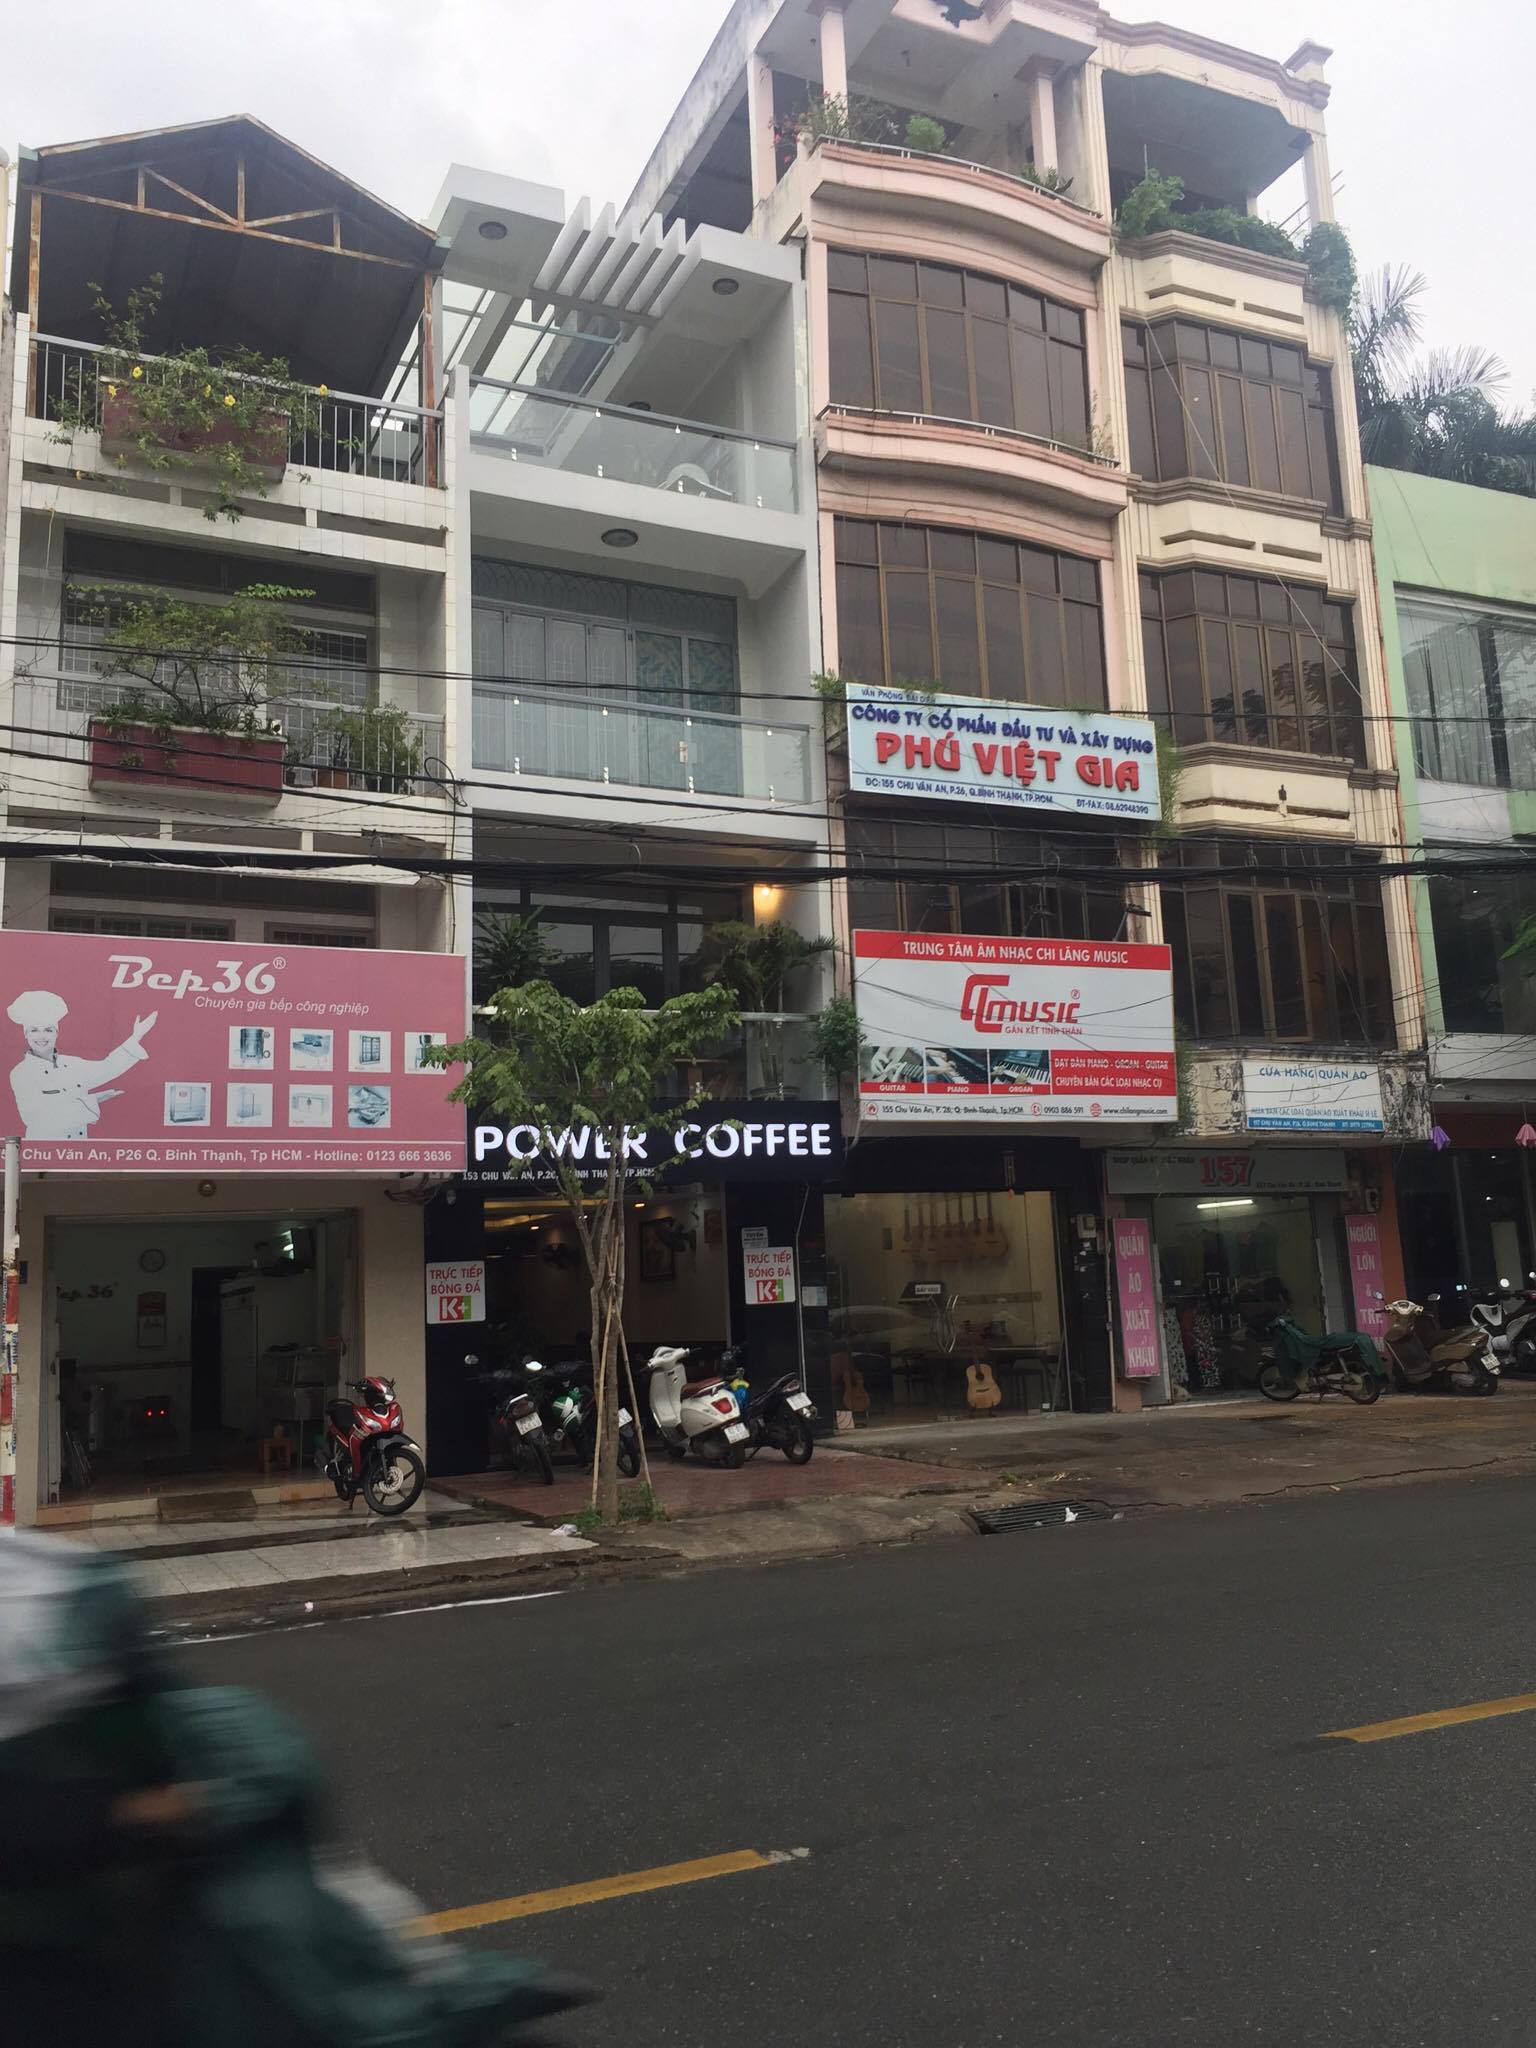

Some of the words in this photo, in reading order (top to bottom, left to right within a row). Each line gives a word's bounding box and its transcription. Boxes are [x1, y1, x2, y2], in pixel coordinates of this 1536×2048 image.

[852, 704, 900, 723] CÔNG
[905, 711, 922, 726] TY
[1036, 726, 1054, 741] TƯ
[1059, 726, 1077, 744] VÀ
[1081, 730, 1109, 748] XÂY
[1114, 736, 1153, 754] DỰNG
[876, 731, 960, 772] PHÚ
[973, 740, 1061, 786] VIỆT
[1076, 755, 1139, 792] GIA
[897, 780, 914, 790] CHU
[916, 781, 932, 792] VĂN
[935, 784, 949, 795] AN,
[903, 941, 944, 956] TRUNG
[948, 941, 973, 957] TÂM
[977, 943, 996, 958] ÂM
[1000, 946, 1032, 963] NHẠC
[1036, 947, 1056, 960] CHI
[1059, 945, 1090, 962] LĂNG
[1094, 950, 1128, 963] MUSIC
[194, 996, 244, 1010] Chuyên
[247, 999, 266, 1011] gia
[270, 999, 292, 1013] bếp
[296, 1001, 326, 1014] công
[329, 1003, 370, 1016] nghiệp
[1087, 1058, 1109, 1068] PIANO
[1145, 1060, 1169, 1070] GUITAR
[1101, 1077, 1114, 1087] CÁC
[474, 1124, 648, 1161] POWER
[674, 1123, 832, 1159] COFFEE
[22, 1148, 51, 1160] Chu
[56, 1149, 83, 1160] Văn
[88, 1149, 111, 1162] An,
[116, 1149, 141, 1160] P26
[146, 1149, 161, 1161] Q.
[201, 1149, 246, 1163] Thạnh,
[251, 1149, 267, 1163] Tp
[272, 1149, 302, 1161] HCM
[314, 1149, 363, 1161] Hotline:
[367, 1150, 395, 1161] 0123
[399, 1150, 421, 1161] 666
[424, 1150, 452, 1161] 3636
[482, 1172, 498, 1180] CHU
[1200, 1156, 1253, 1186] 157
[773, 1250, 791, 1263] TIẾP
[431, 1266, 456, 1281] TRỰC
[461, 1264, 483, 1278] TIẾP
[748, 1265, 774, 1278] BÓNG
[778, 1265, 791, 1277] ĐÁ
[431, 1282, 461, 1295] BÓNG
[465, 1280, 480, 1292] ĐÁ
[758, 1281, 782, 1301] K+
[442, 1298, 468, 1319] K+
